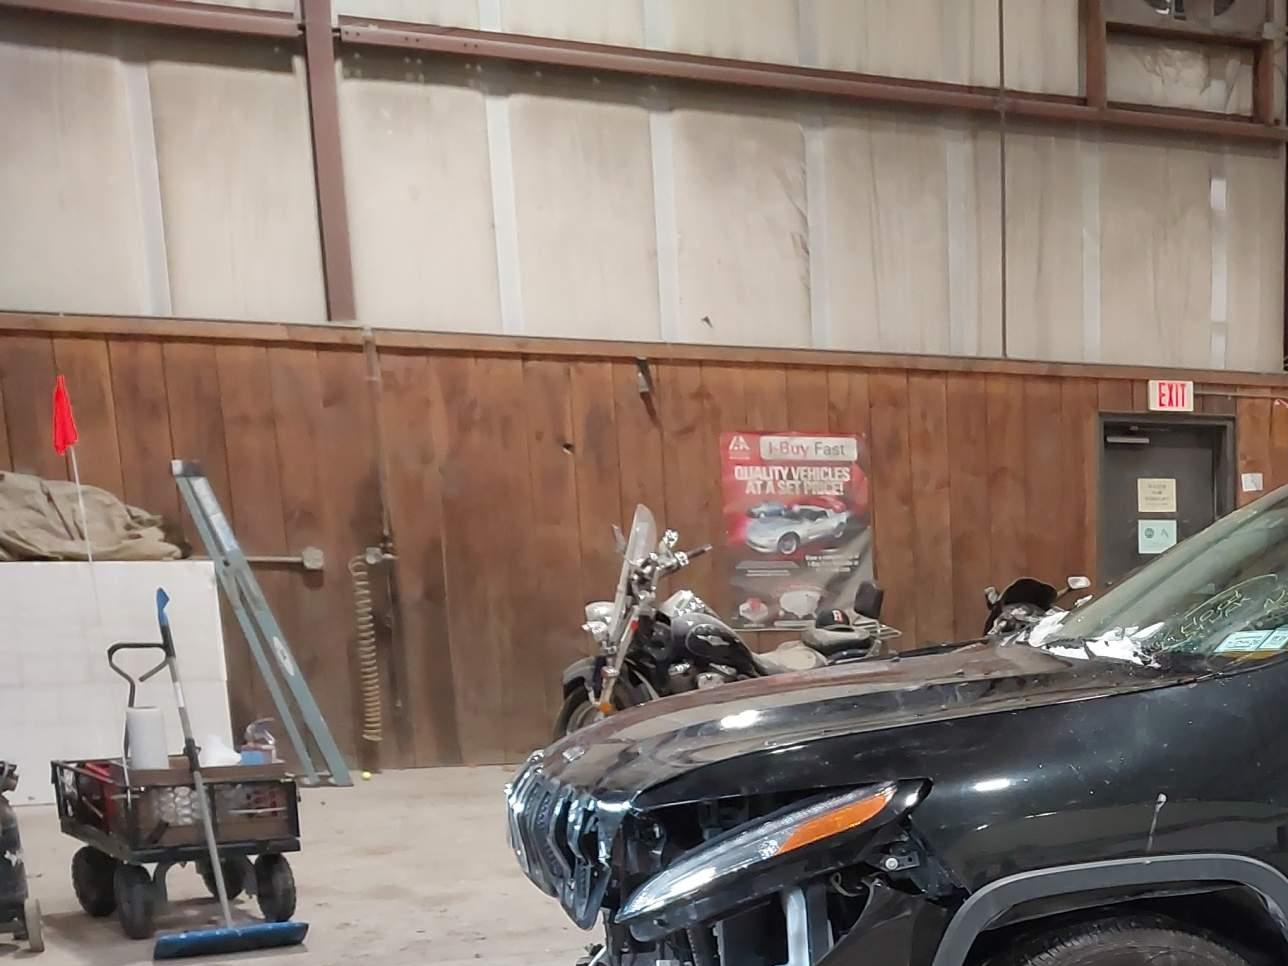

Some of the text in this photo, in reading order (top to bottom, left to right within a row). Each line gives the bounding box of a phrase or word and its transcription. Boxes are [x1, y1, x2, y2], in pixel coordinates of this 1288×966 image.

[1158, 382, 1187, 408] EXIT
[769, 441, 846, 456] I-Buy Fast
[734, 466, 851, 481] QUALITY VEHICLES
[745, 481, 844, 495] AT A SET PRICE!
